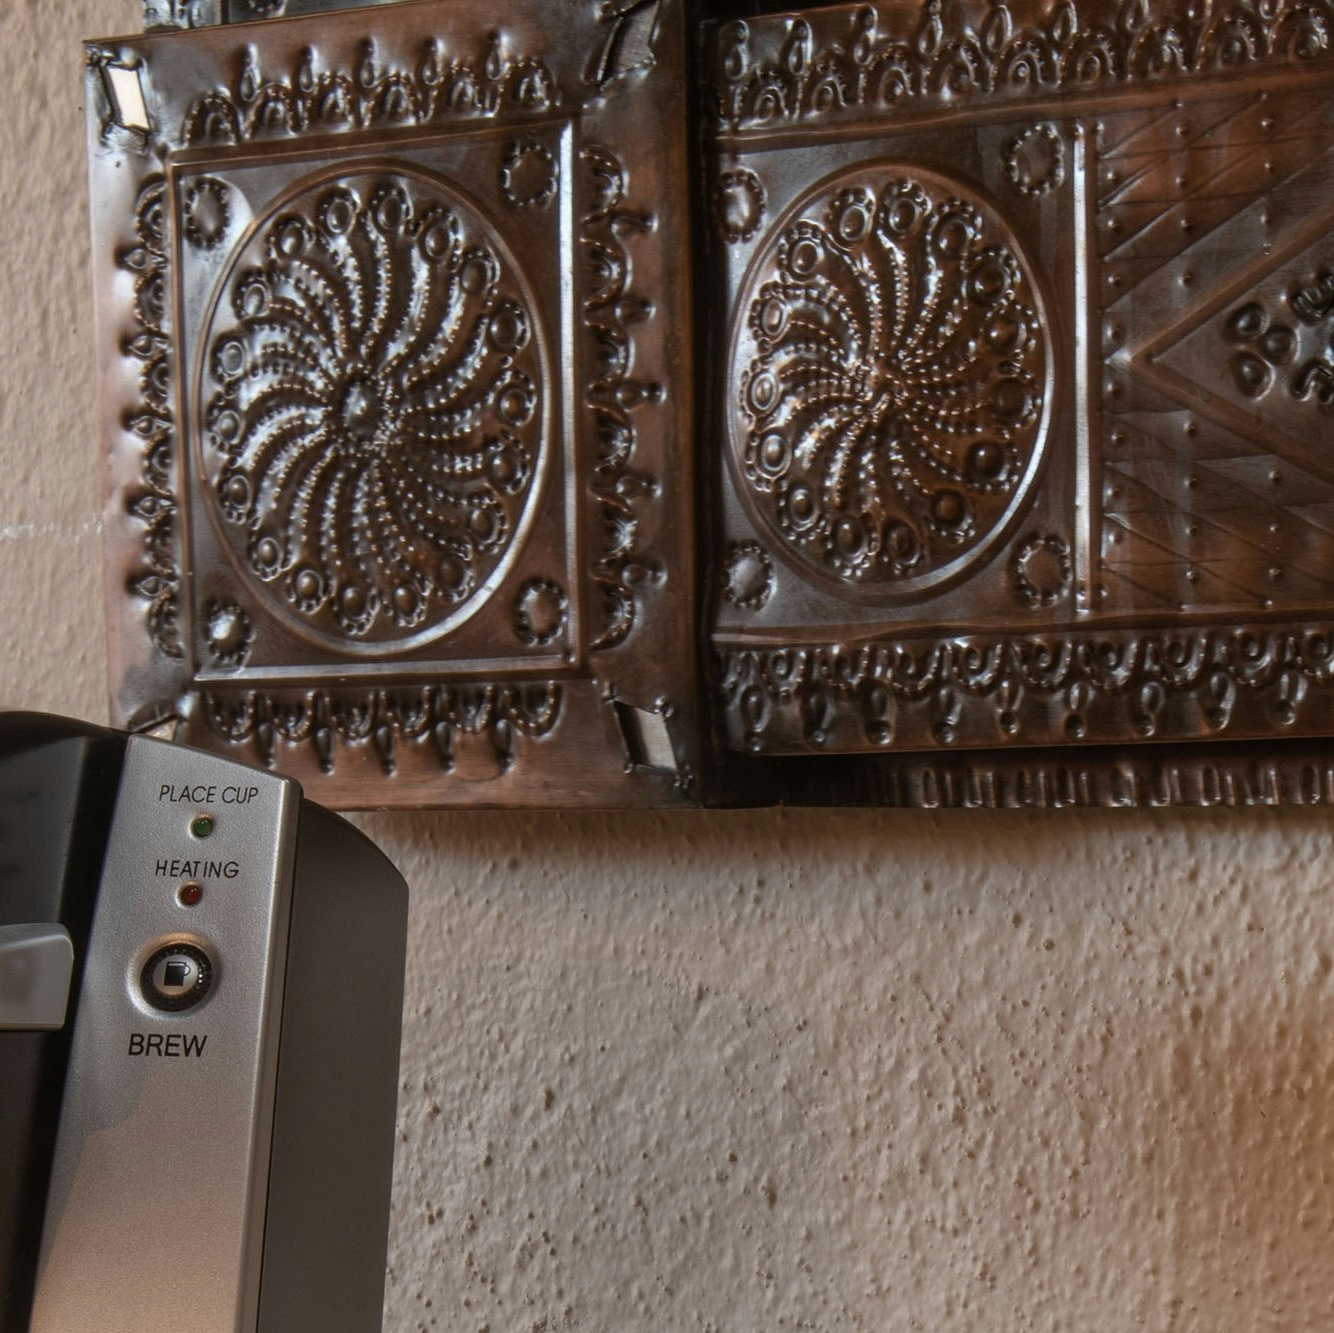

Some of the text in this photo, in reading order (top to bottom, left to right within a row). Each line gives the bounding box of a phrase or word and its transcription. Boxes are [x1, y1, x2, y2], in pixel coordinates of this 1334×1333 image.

[159, 785, 259, 804] PLACE CUP
[155, 860, 239, 879] HEATING
[128, 1034, 208, 1057] BREW
